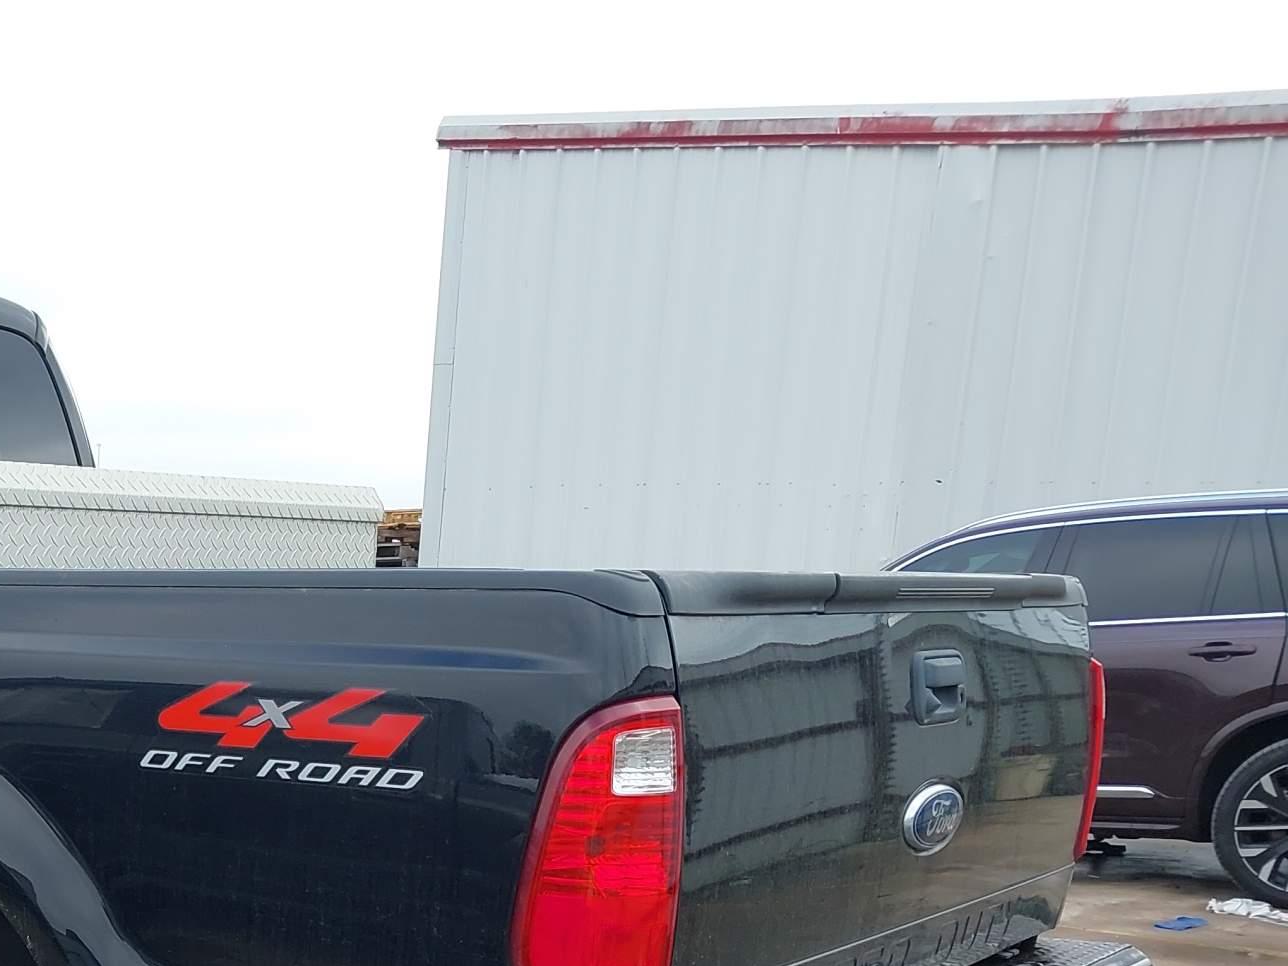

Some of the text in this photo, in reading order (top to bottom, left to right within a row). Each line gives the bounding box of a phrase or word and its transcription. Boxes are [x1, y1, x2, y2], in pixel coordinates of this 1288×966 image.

[139, 749, 425, 791] OFF ROAD
[926, 799, 958, 837] Ford
